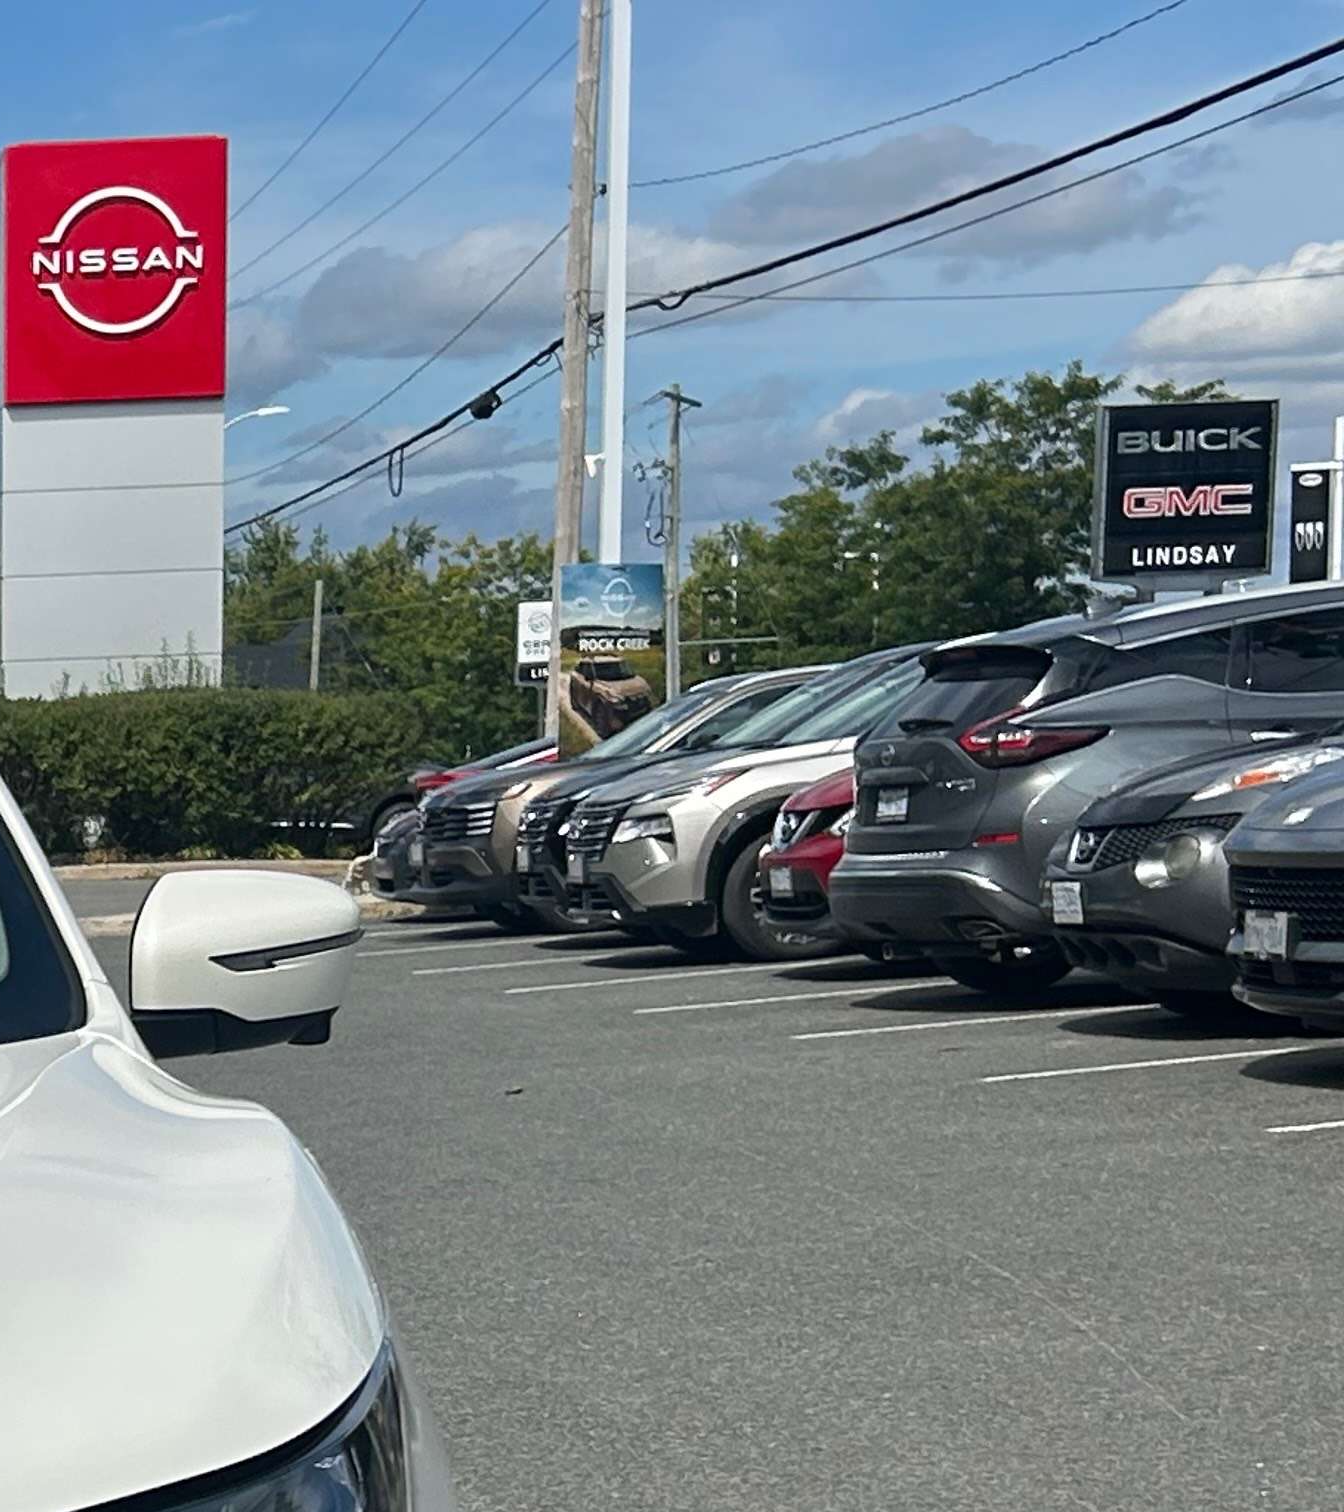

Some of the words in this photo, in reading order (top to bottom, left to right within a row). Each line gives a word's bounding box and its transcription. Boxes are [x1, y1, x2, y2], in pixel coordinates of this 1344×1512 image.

[32, 244, 204, 275] NISSAN
[1116, 426, 1262, 454] BUICK
[1123, 483, 1253, 518] GMC
[1132, 545, 1236, 566] LINDSAY
[579, 638, 615, 652] ROCK
